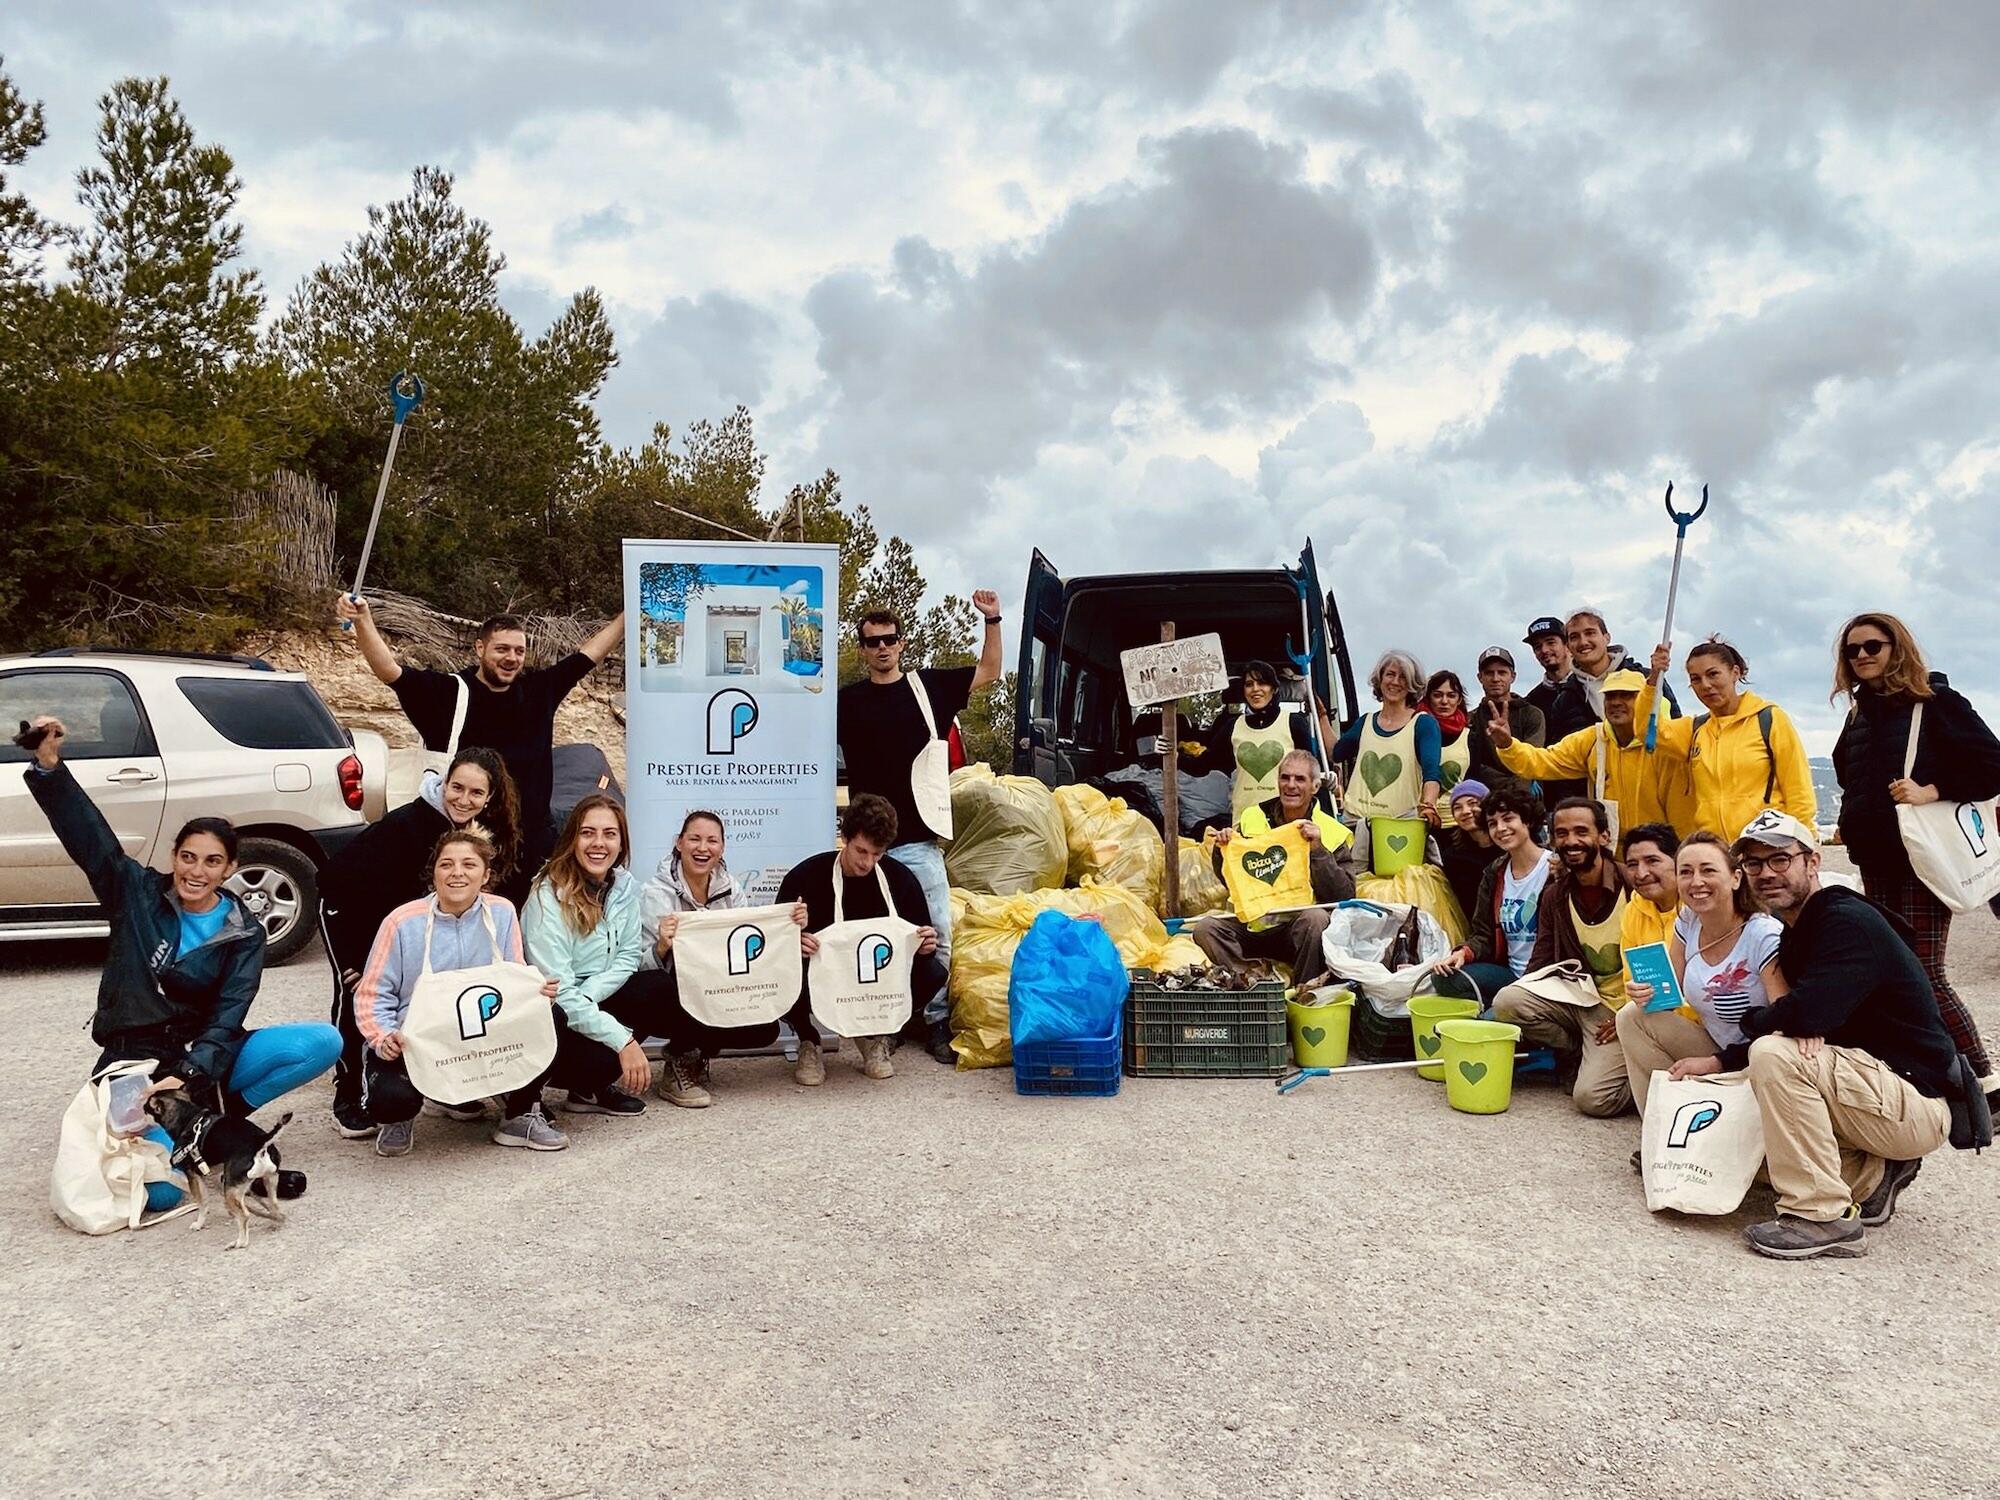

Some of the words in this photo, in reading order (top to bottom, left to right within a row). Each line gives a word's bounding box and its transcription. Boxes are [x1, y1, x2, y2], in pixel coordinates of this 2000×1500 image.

[647, 762, 721, 776] PRESTIGE
[727, 762, 818, 776] PROPERTIES
[693, 778, 729, 786] RENTALS
[739, 777, 798, 785] MANAGEMENT
[732, 808, 779, 816] PARADISE
[733, 818, 763, 826] HOME
[435, 1053, 471, 1068] PRESTIGE
[478, 1043, 524, 1058] PROPERTIES
